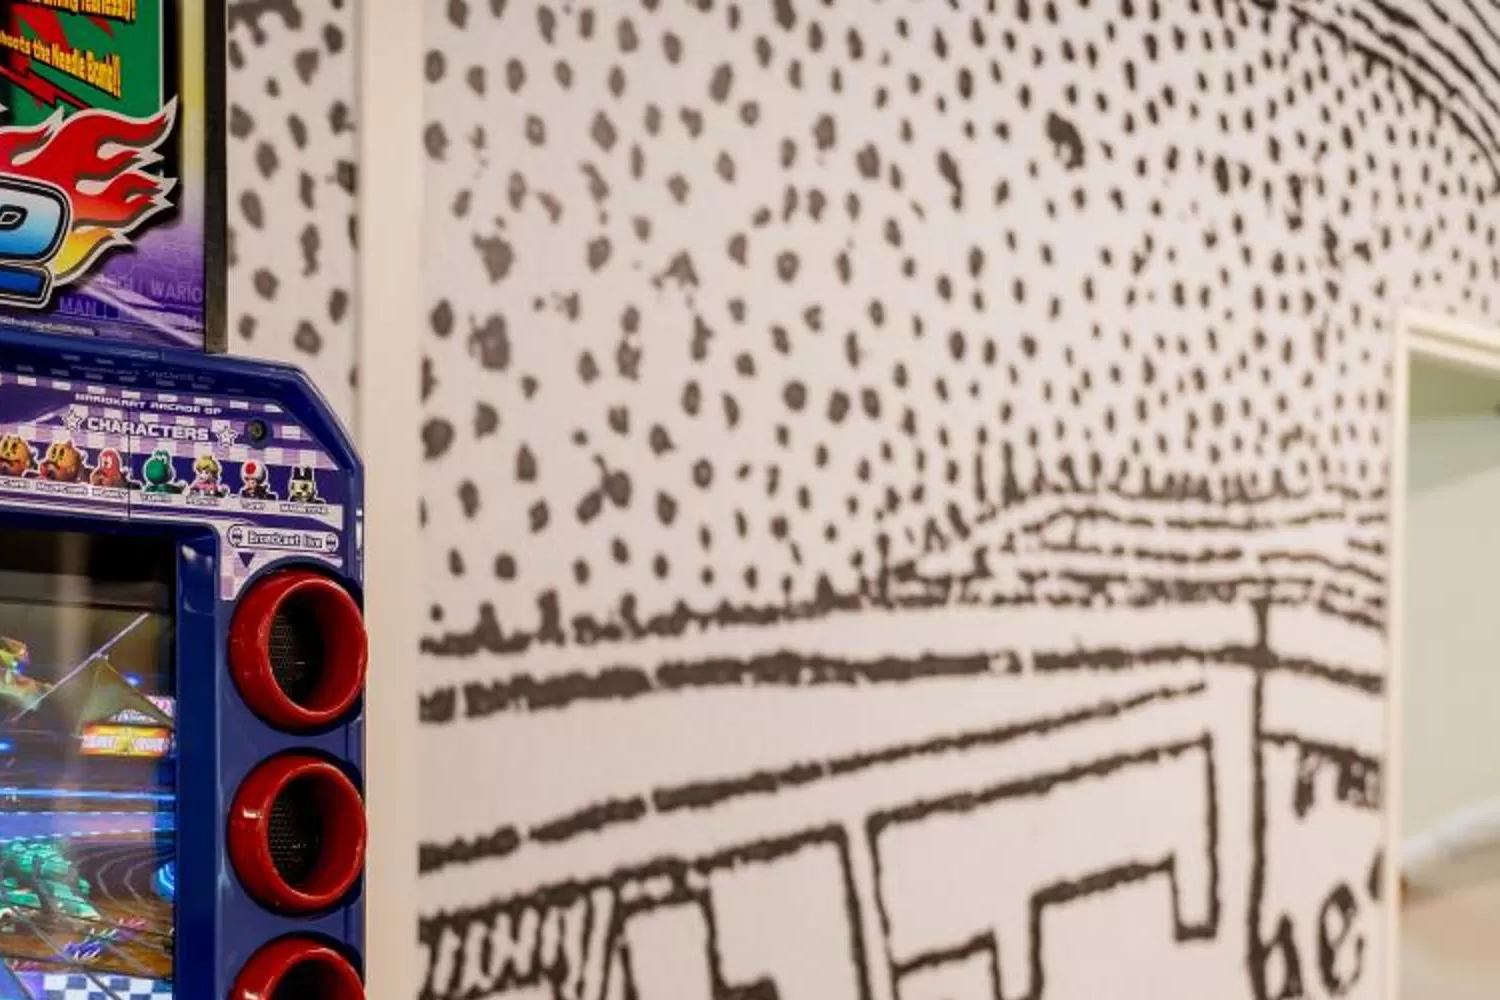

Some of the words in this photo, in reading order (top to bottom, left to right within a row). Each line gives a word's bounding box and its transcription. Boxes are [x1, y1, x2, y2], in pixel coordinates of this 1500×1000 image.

[32, 38, 51, 62] the
[51, 43, 86, 79] Needle
[87, 416, 209, 442] CHARACTERS
